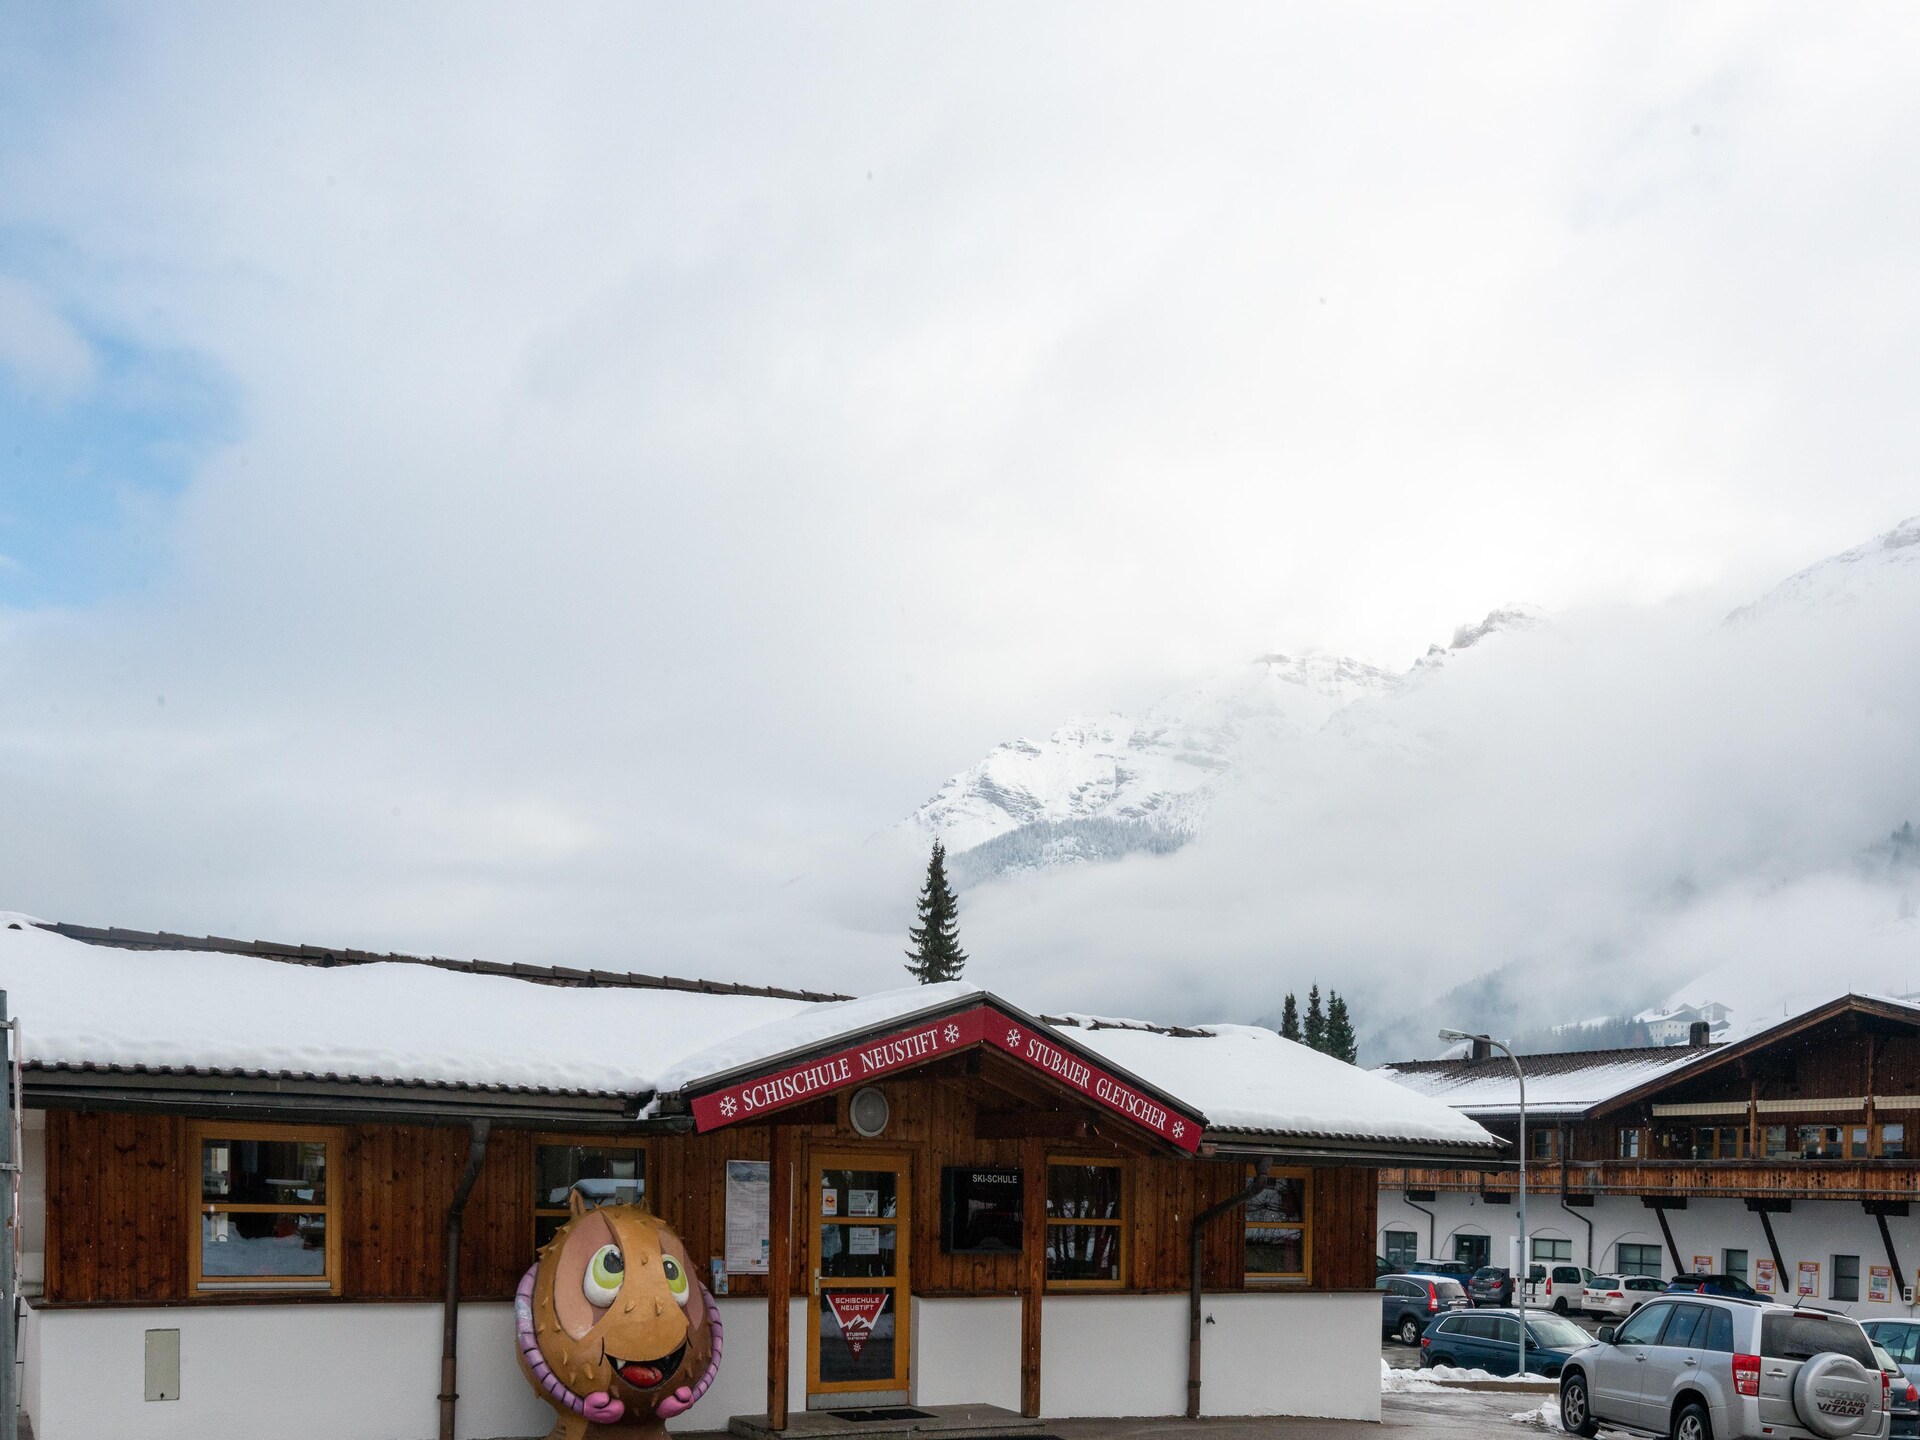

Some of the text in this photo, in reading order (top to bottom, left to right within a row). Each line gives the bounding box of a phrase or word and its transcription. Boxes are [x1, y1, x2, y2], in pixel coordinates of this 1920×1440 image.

[742, 1029, 939, 1112] SCHISCHULE NEUSTIFT
[1026, 1038, 1167, 1131] STUBAIER GLETSCHER
[972, 1174, 1018, 1184] SKI-SCHULE
[1815, 1386, 1870, 1403] SUZUKI
[1816, 1402, 1865, 1416] VITARA
[1833, 1399, 1866, 1408] GRAND
